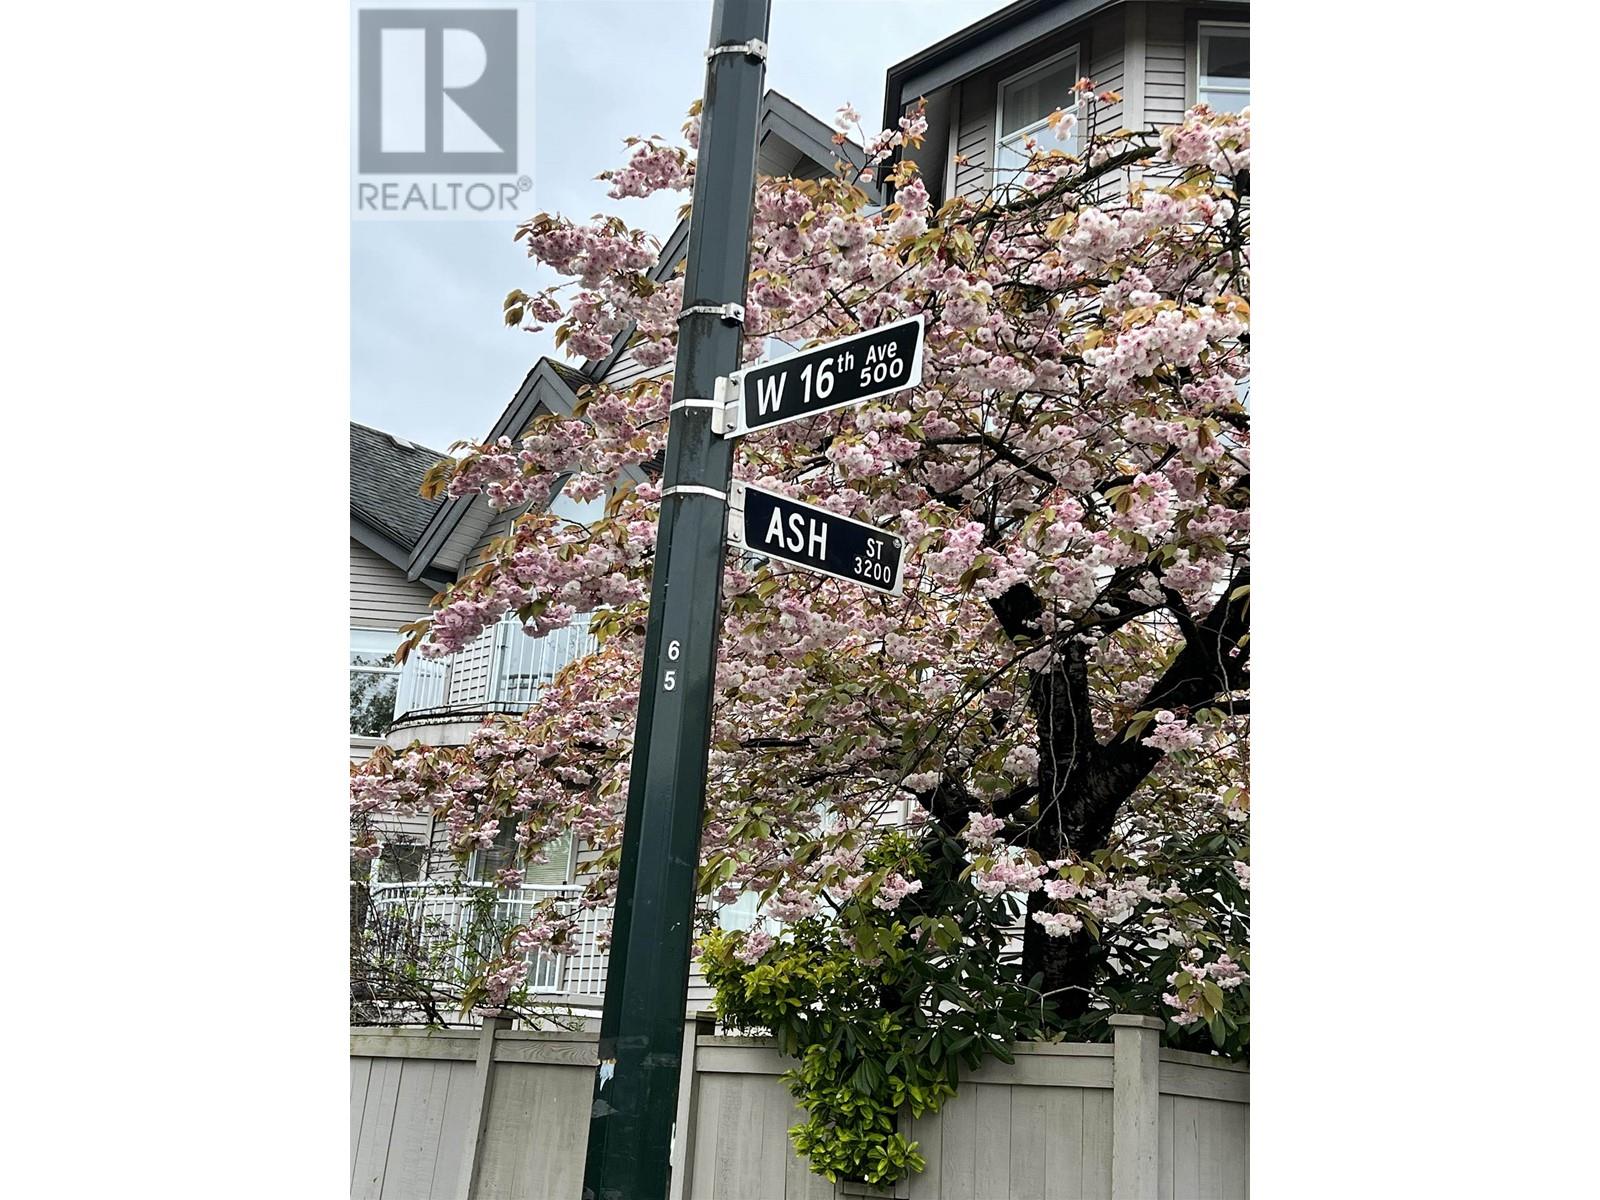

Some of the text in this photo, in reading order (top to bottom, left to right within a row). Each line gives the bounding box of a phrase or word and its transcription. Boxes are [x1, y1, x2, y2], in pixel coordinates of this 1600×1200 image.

[866, 341, 898, 365] Ave
[757, 351, 855, 416] W 16th
[860, 360, 904, 388] 500
[765, 506, 828, 561] ASH
[866, 538, 884, 560] ST
[854, 556, 891, 583] 3200
[668, 640, 680, 660] 6
[664, 671, 676, 690] 5
